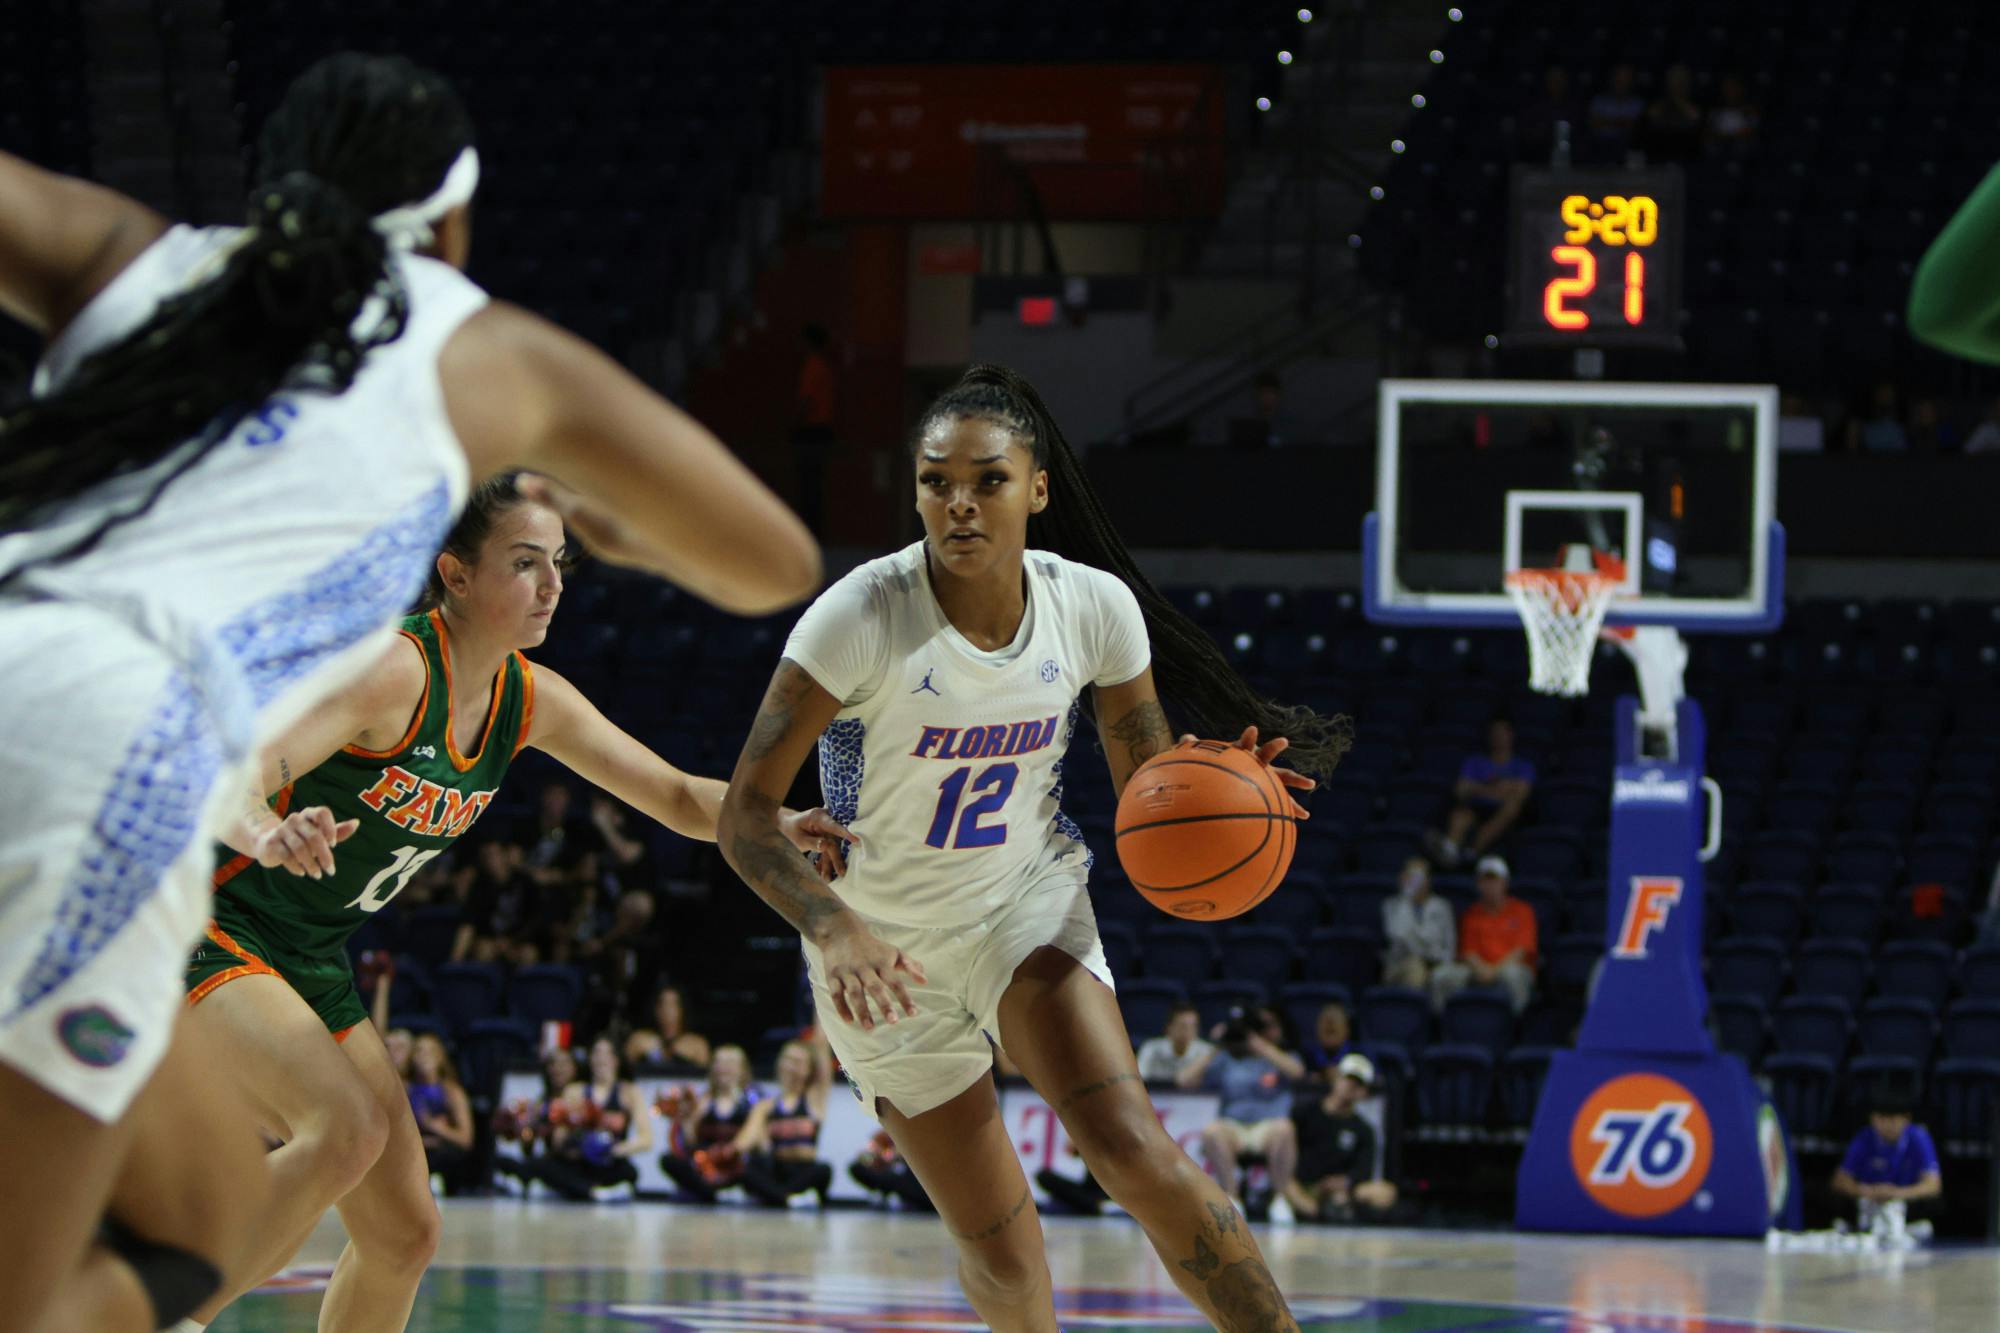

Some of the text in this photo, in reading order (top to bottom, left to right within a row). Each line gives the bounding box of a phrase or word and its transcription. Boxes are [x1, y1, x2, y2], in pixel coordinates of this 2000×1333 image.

[1561, 195, 1658, 246] 5:20
[1544, 246, 1643, 329] 21
[909, 715, 1059, 759] FLORIDA
[924, 762, 1020, 849] 12
[1611, 876, 1683, 959] F
[1590, 1101, 1696, 1188] 76
